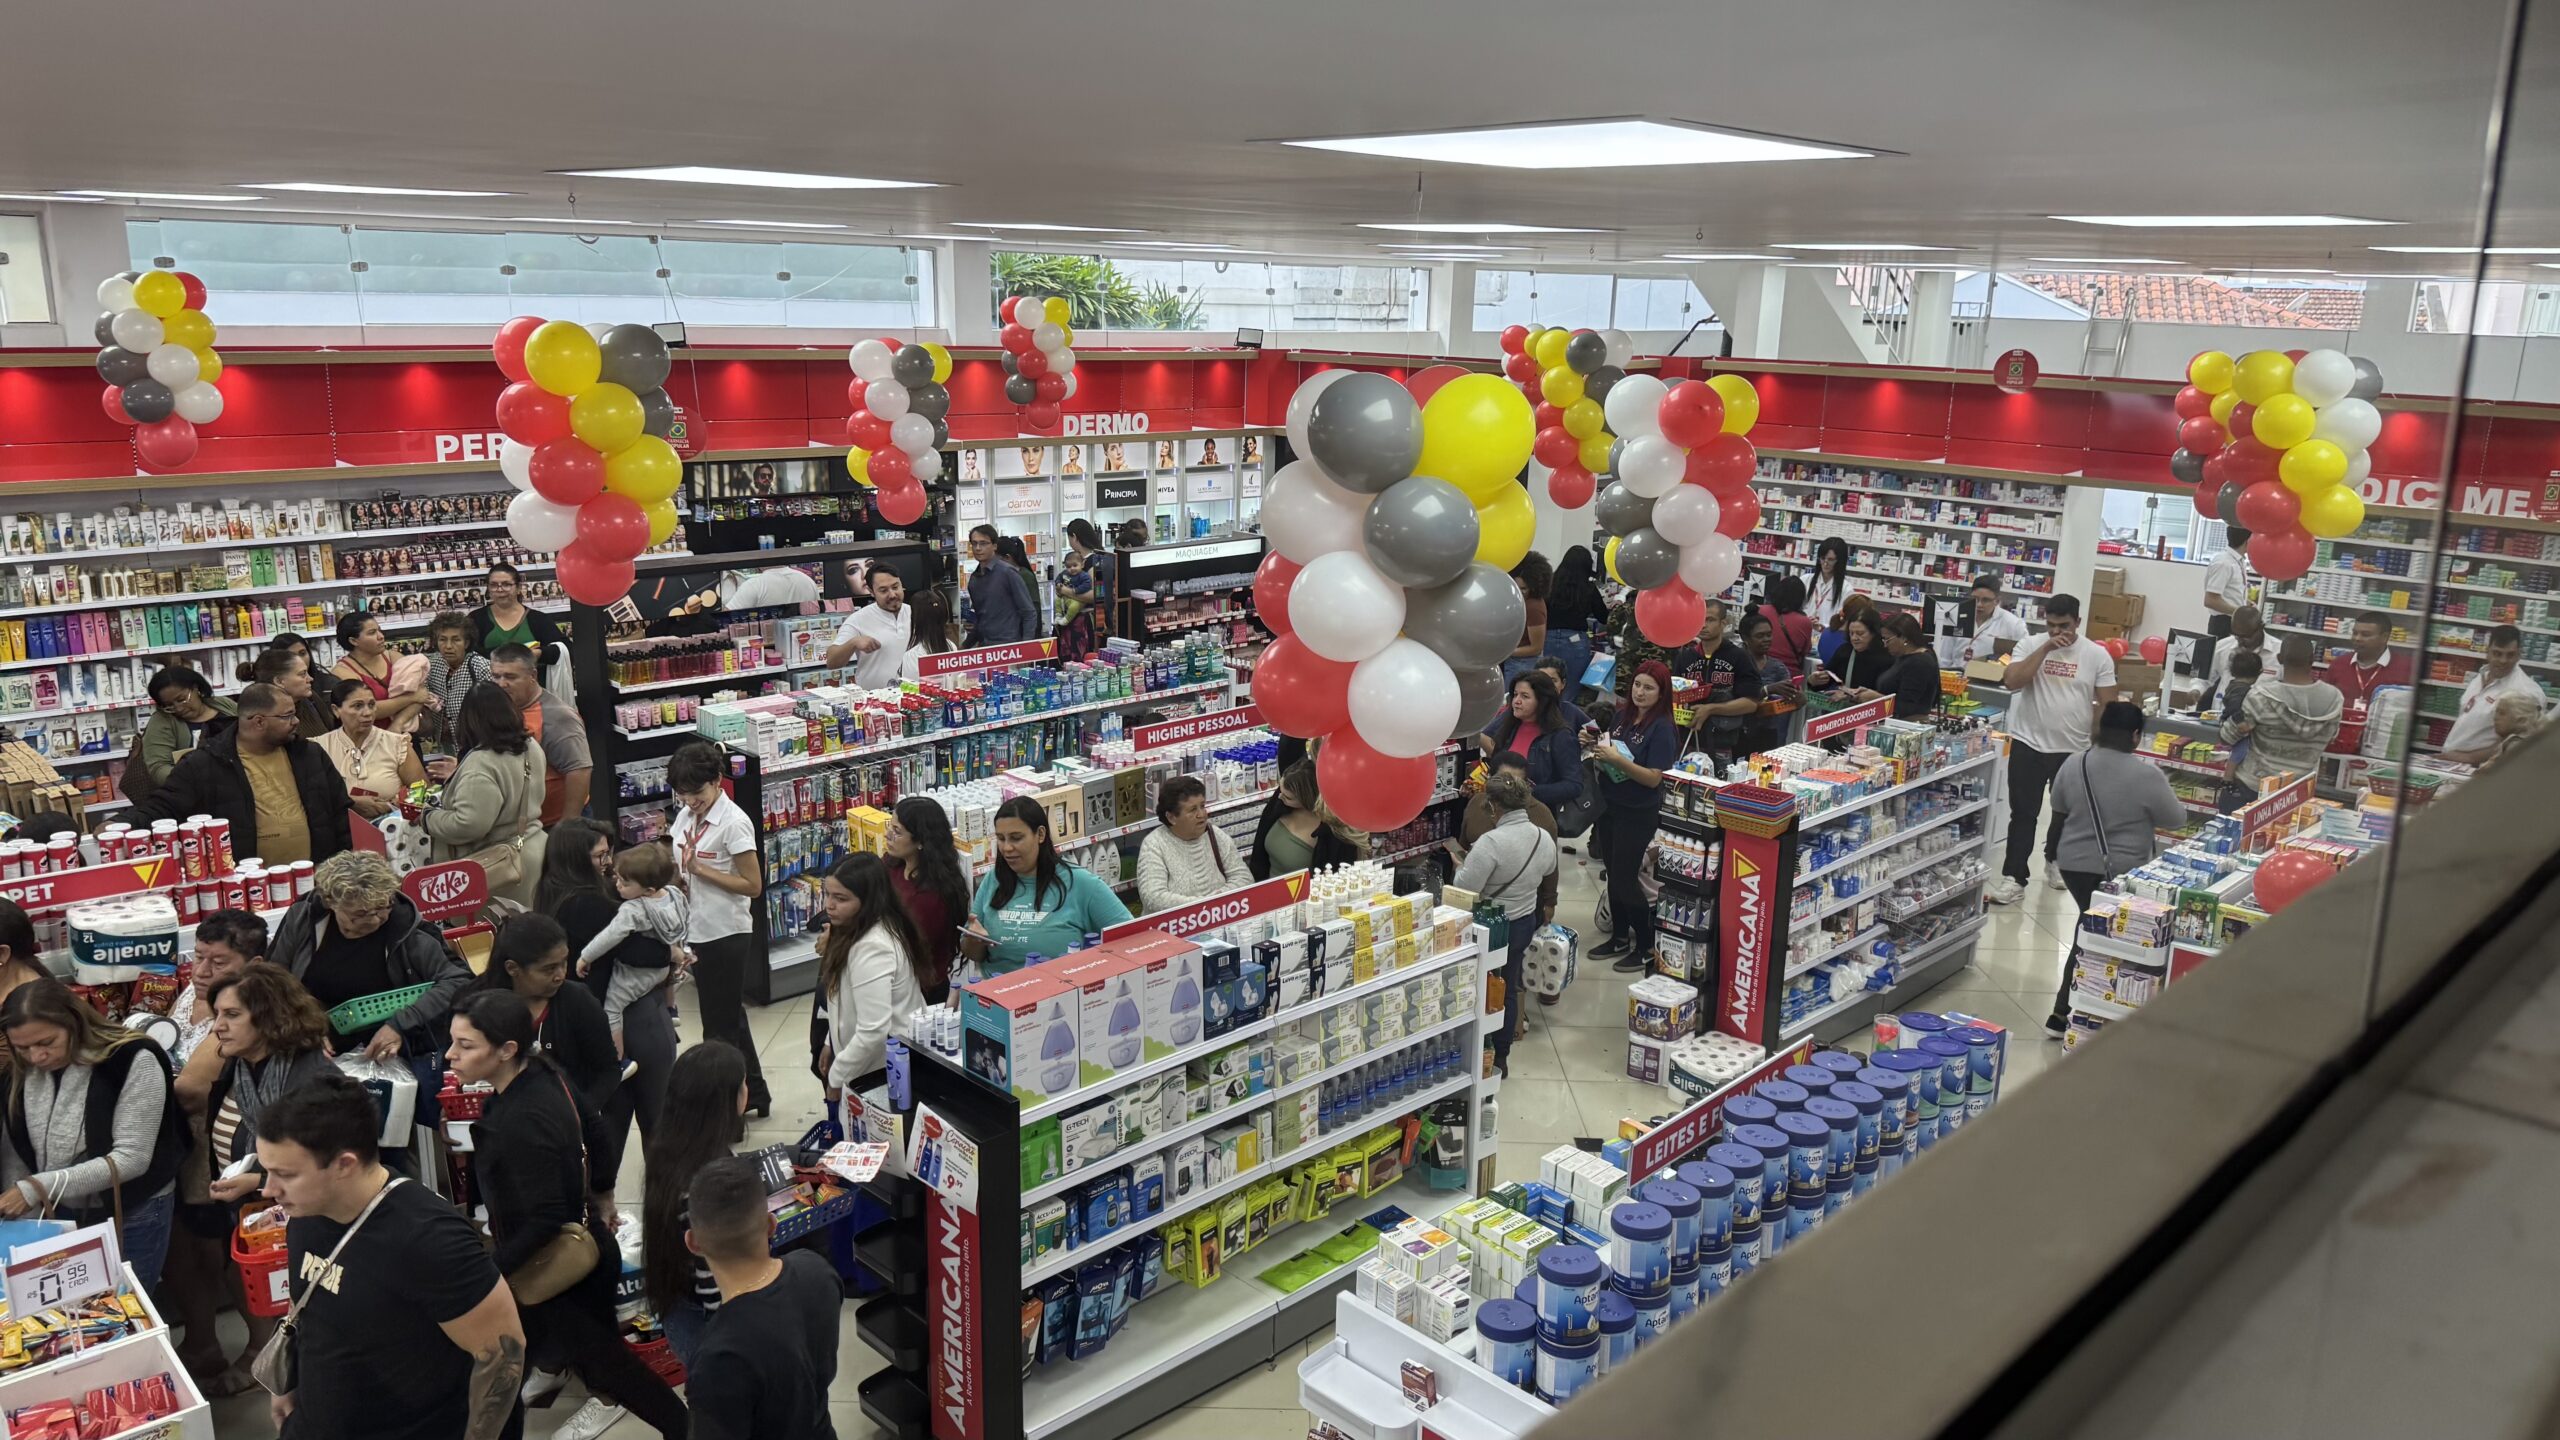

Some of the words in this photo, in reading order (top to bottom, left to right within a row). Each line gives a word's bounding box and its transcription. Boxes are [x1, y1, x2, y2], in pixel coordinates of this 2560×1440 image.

[1063, 413, 1149, 436] DERMO
[1104, 488, 1138, 500] PRINCIPIA
[961, 498, 984, 507] VICHY
[1008, 499, 1042, 509] darrow
[1175, 546, 1219, 559] MAQUIAGEM
[937, 655, 984, 670] HIGIENE
[986, 648, 1022, 664] BUCAL
[1714, 658, 1734, 672] SEVEN
[1147, 724, 1195, 744] HIGIENE
[1198, 712, 1249, 734] PESSOAL
[1815, 715, 1845, 735] PRIMEIROS
[1845, 707, 1876, 725] SOCORROS
[2253, 807, 2272, 826] LINHA
[2272, 789, 2298, 815] INFANTIL
[8, 882, 54, 904] PET
[426, 872, 467, 902] KitKat
[1150, 897, 1250, 936] CESSÓRIOS
[93, 940, 172, 963] Atualle
[1730, 875, 1761, 1034] AMERICANA
[1636, 1005, 1668, 1021] Max
[1066, 1117, 1089, 1132] G-TECH
[1645, 1121, 1695, 1170] LEITES
[1699, 1113, 1708, 1133] E
[1864, 1135, 1873, 1149] 3
[1178, 1145, 1199, 1162] G-TECH
[1842, 1151, 1851, 1165] 3
[1139, 1164, 1159, 1178] G-TECH
[1773, 1181, 1783, 1197] 2
[1740, 1248, 1760, 1261] Apta
[68, 1277, 89, 1288] CADA
[1710, 1269, 1730, 1282] Apta
[27, 1291, 38, 1299] R$
[1573, 1291, 1599, 1306] Apta
[940, 1196, 966, 1437] AMERICANA
[1644, 1314, 1670, 1328] Apta
